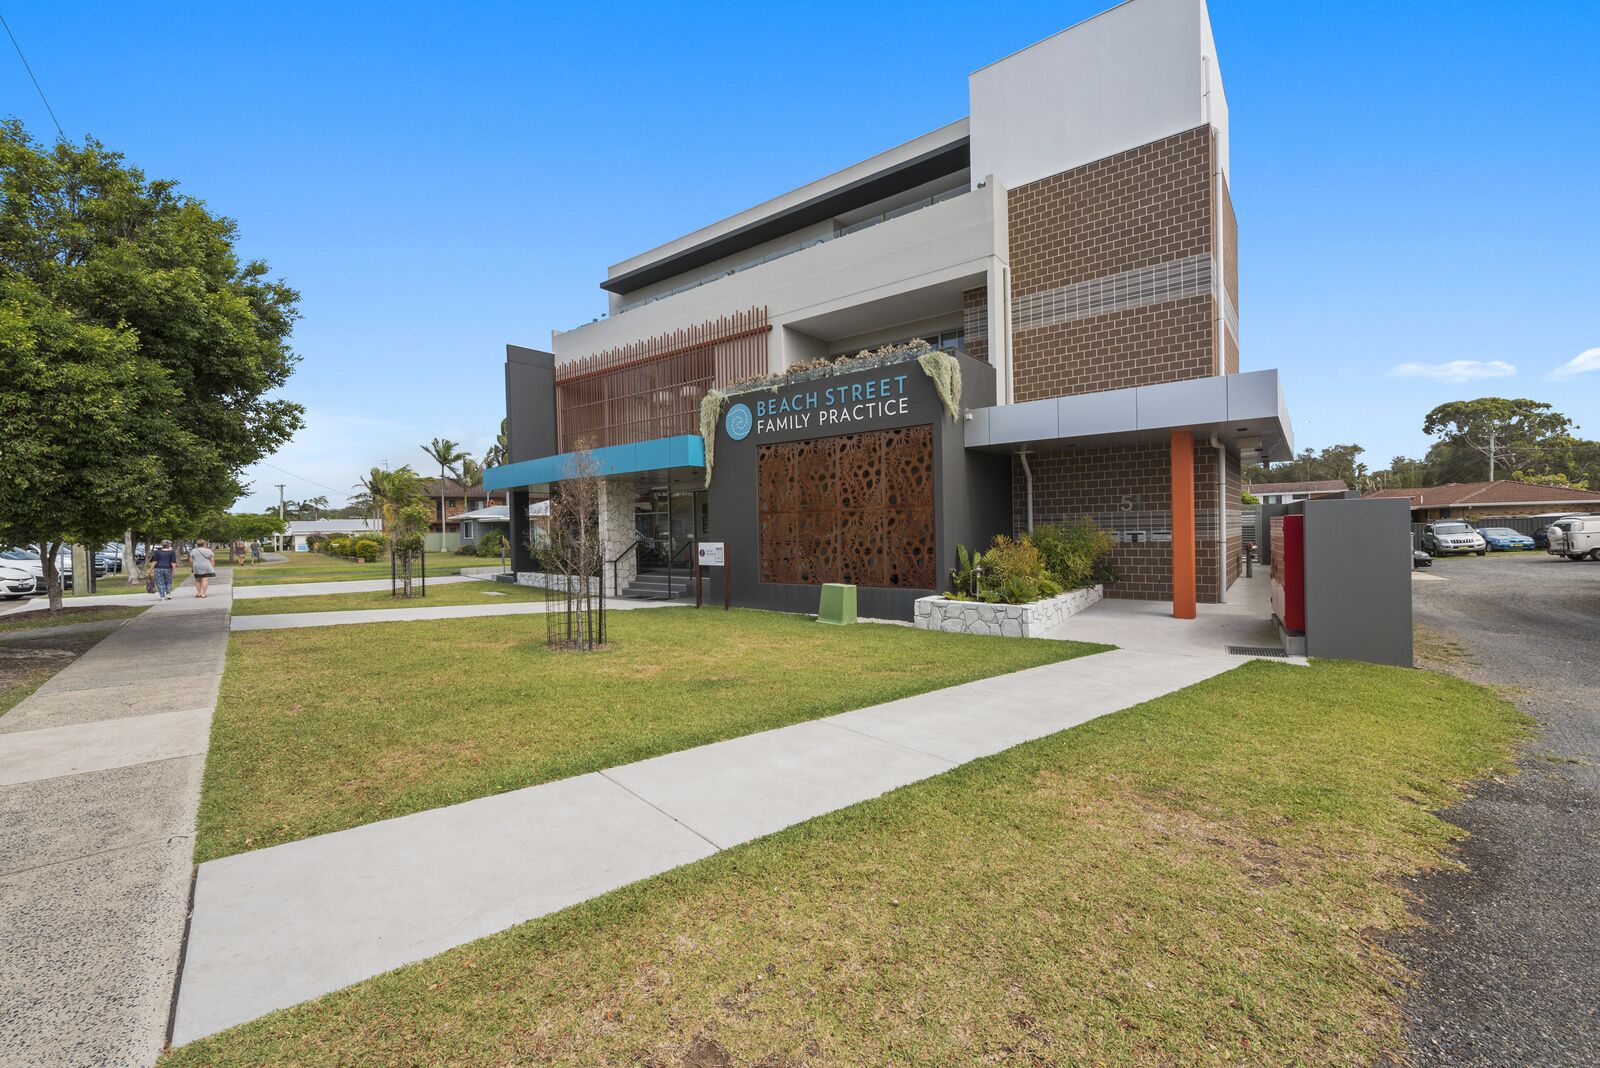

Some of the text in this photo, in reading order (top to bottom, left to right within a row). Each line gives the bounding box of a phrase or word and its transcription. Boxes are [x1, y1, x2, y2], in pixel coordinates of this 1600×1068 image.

[756, 397, 909, 434] FAMILY PRACTICE
[757, 375, 908, 417] BEACH STREET
